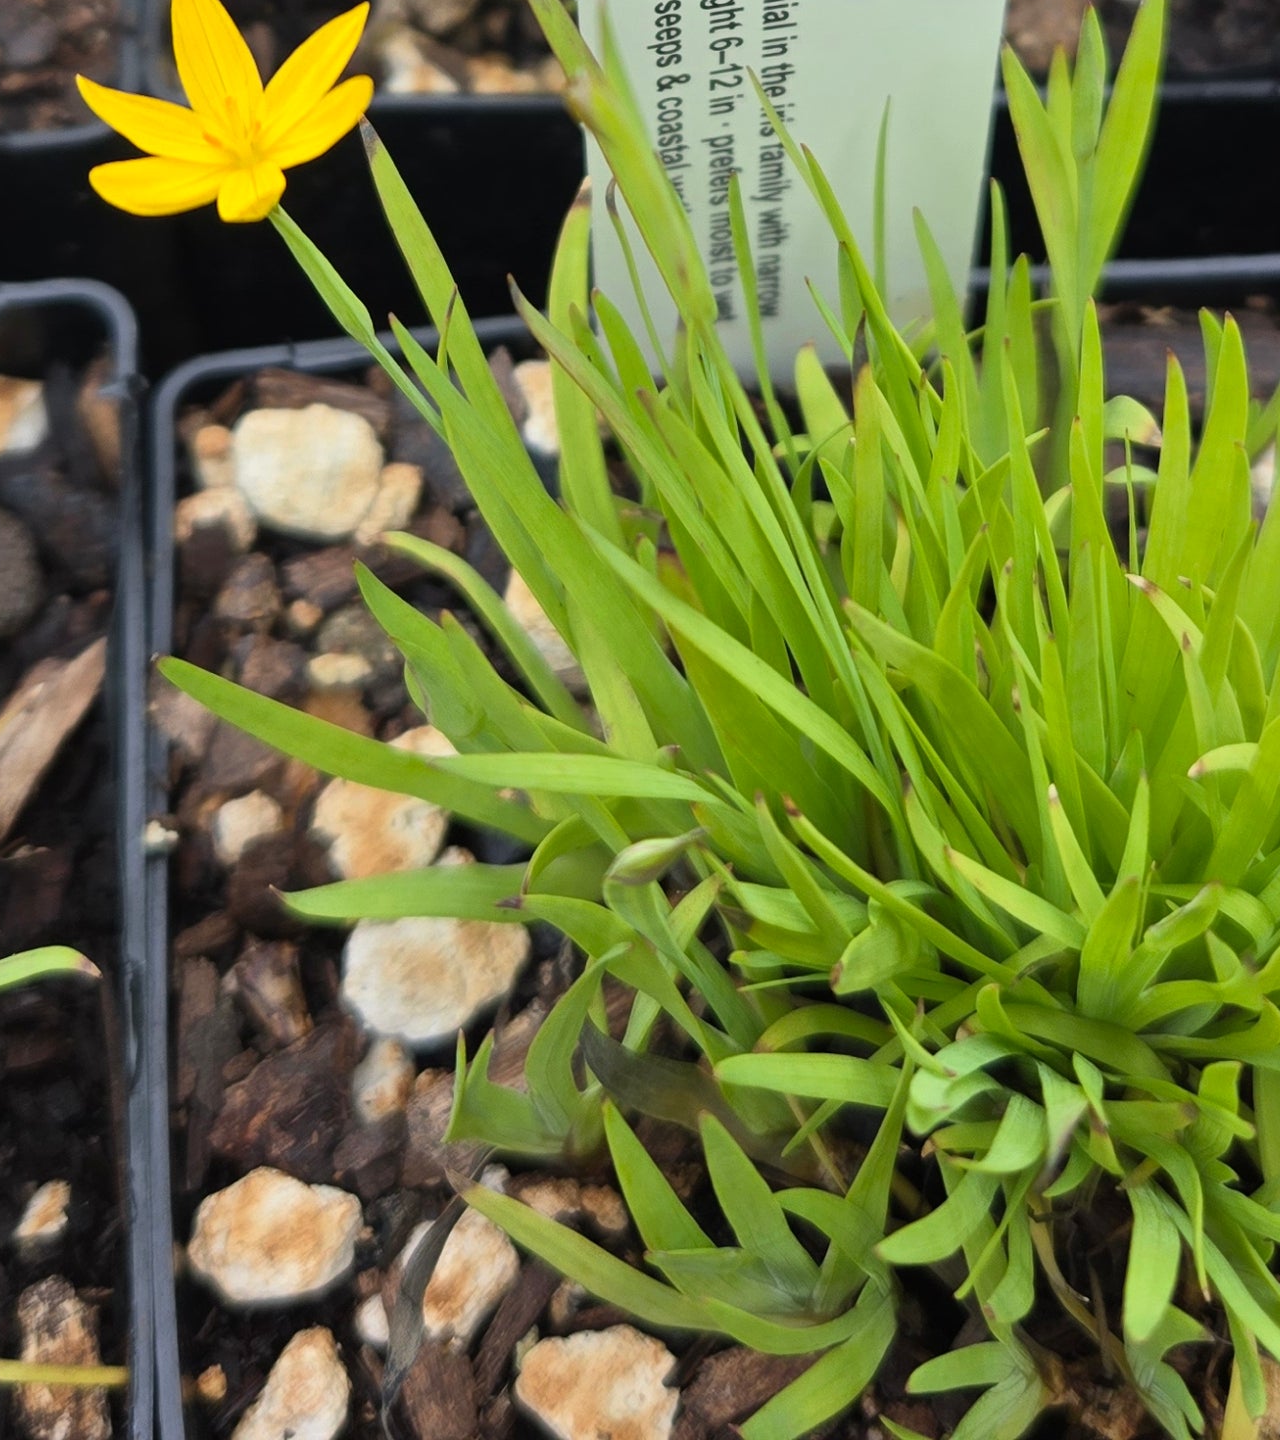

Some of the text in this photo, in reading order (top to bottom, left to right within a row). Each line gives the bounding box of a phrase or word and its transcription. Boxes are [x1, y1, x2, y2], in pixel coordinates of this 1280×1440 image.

[646, 0, 683, 68] seeps
[761, 35, 798, 58] in
[656, 73, 692, 93] &
[756, 62, 796, 98] the
[709, 93, 744, 116] in
[653, 96, 692, 172] coastal
[757, 207, 790, 249] with
[710, 266, 738, 288] to
